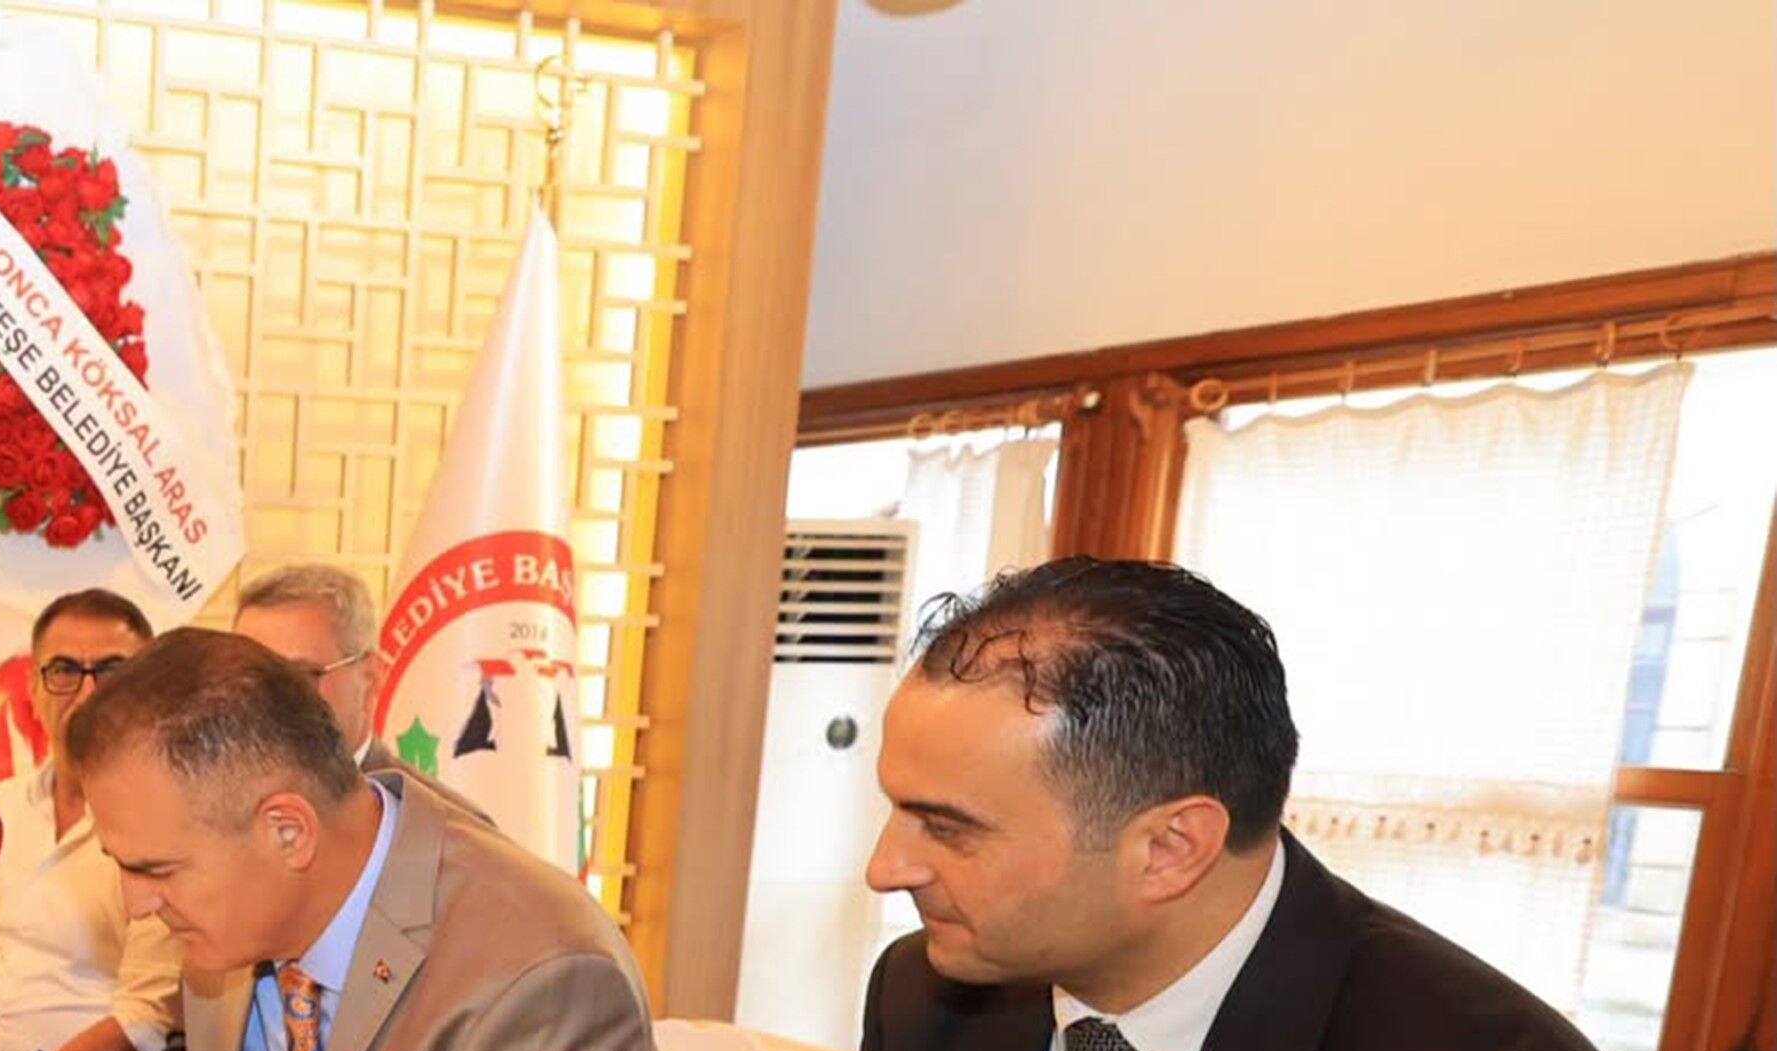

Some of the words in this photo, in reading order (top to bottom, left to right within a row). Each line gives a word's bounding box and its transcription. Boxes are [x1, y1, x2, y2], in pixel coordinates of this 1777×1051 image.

[35, 365, 138, 497] BELEDİYE
[123, 490, 203, 602] BAŞKANI
[62, 338, 161, 468] KÖKSAL
[153, 466, 207, 545] ARAS
[377, 558, 500, 667] LEDİYE
[513, 552, 574, 607] BAŞ
